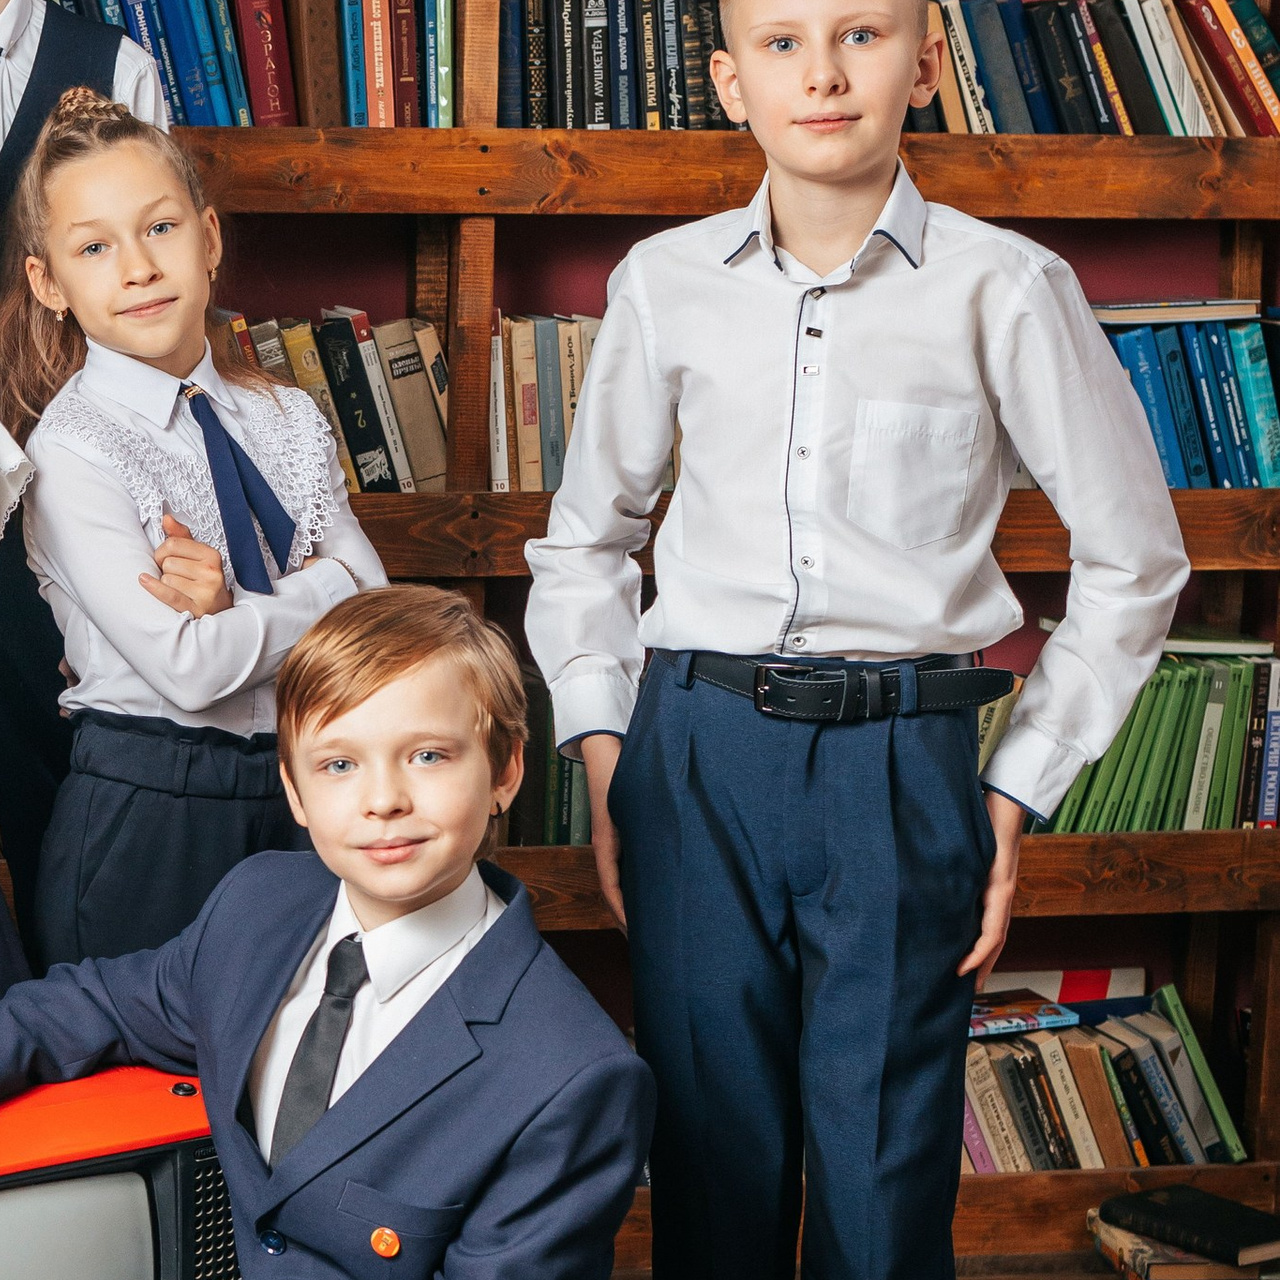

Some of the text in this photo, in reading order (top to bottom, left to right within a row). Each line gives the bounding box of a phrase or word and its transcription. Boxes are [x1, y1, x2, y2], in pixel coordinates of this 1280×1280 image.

[257, 29, 283, 112] ЭРАГОН
[563, 47, 573, 88] альманах
[589, 29, 605, 122] ТРИ МУШКЕТЁРА
[618, 36, 627, 69] АДАМОВ
[642, 11, 656, 106] РУССКАЯ СЛОВЕСНОСТЬ
[563, 89, 573, 128] ратурный
[1247, 58, 1280, 117] ЧТЕНИЕ
